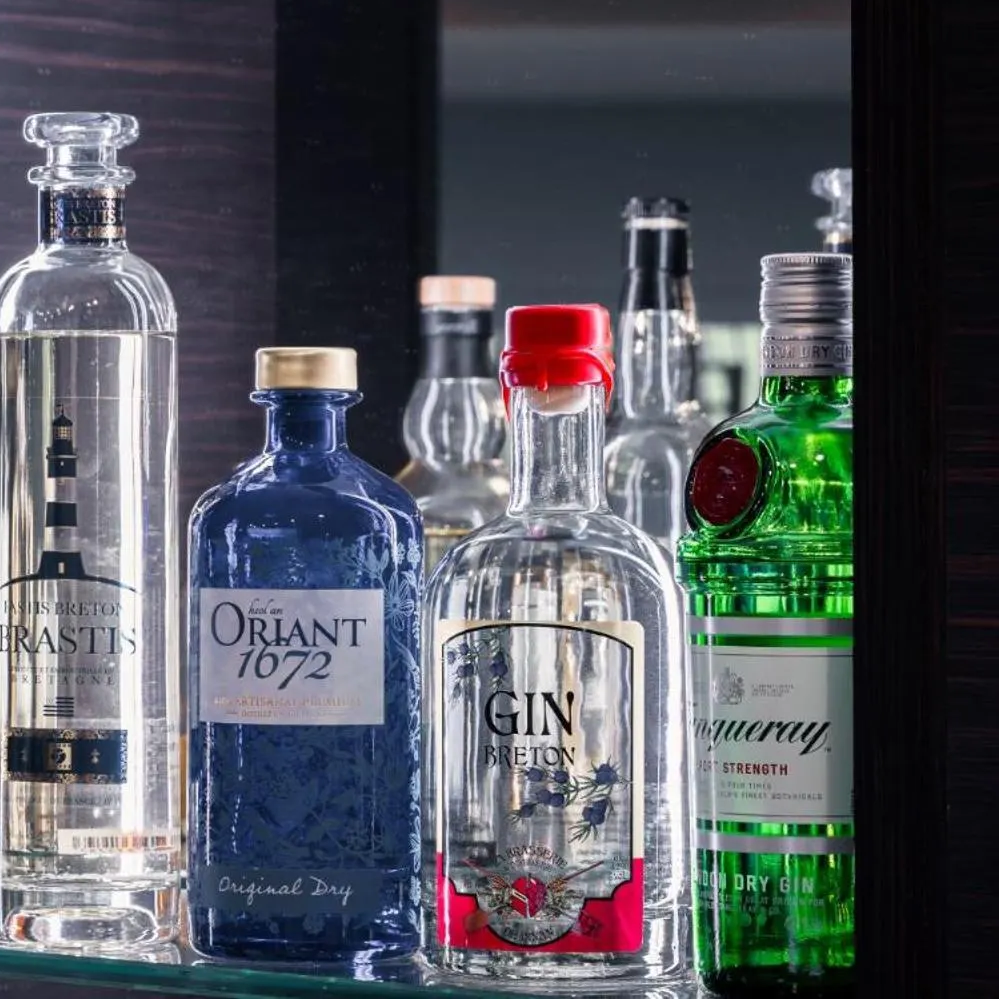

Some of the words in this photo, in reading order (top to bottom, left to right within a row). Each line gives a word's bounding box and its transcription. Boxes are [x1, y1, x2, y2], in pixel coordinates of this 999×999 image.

[210, 601, 367, 648] ORIANT
[237, 637, 332, 690] 1672
[484, 690, 576, 738] GIN
[484, 746, 576, 770] BRETON
[722, 761, 789, 776] STRENGTH
[218, 875, 304, 906] Original
[309, 875, 354, 907] Dry
[734, 873, 770, 893] DRY
[779, 876, 814, 894] GIN
